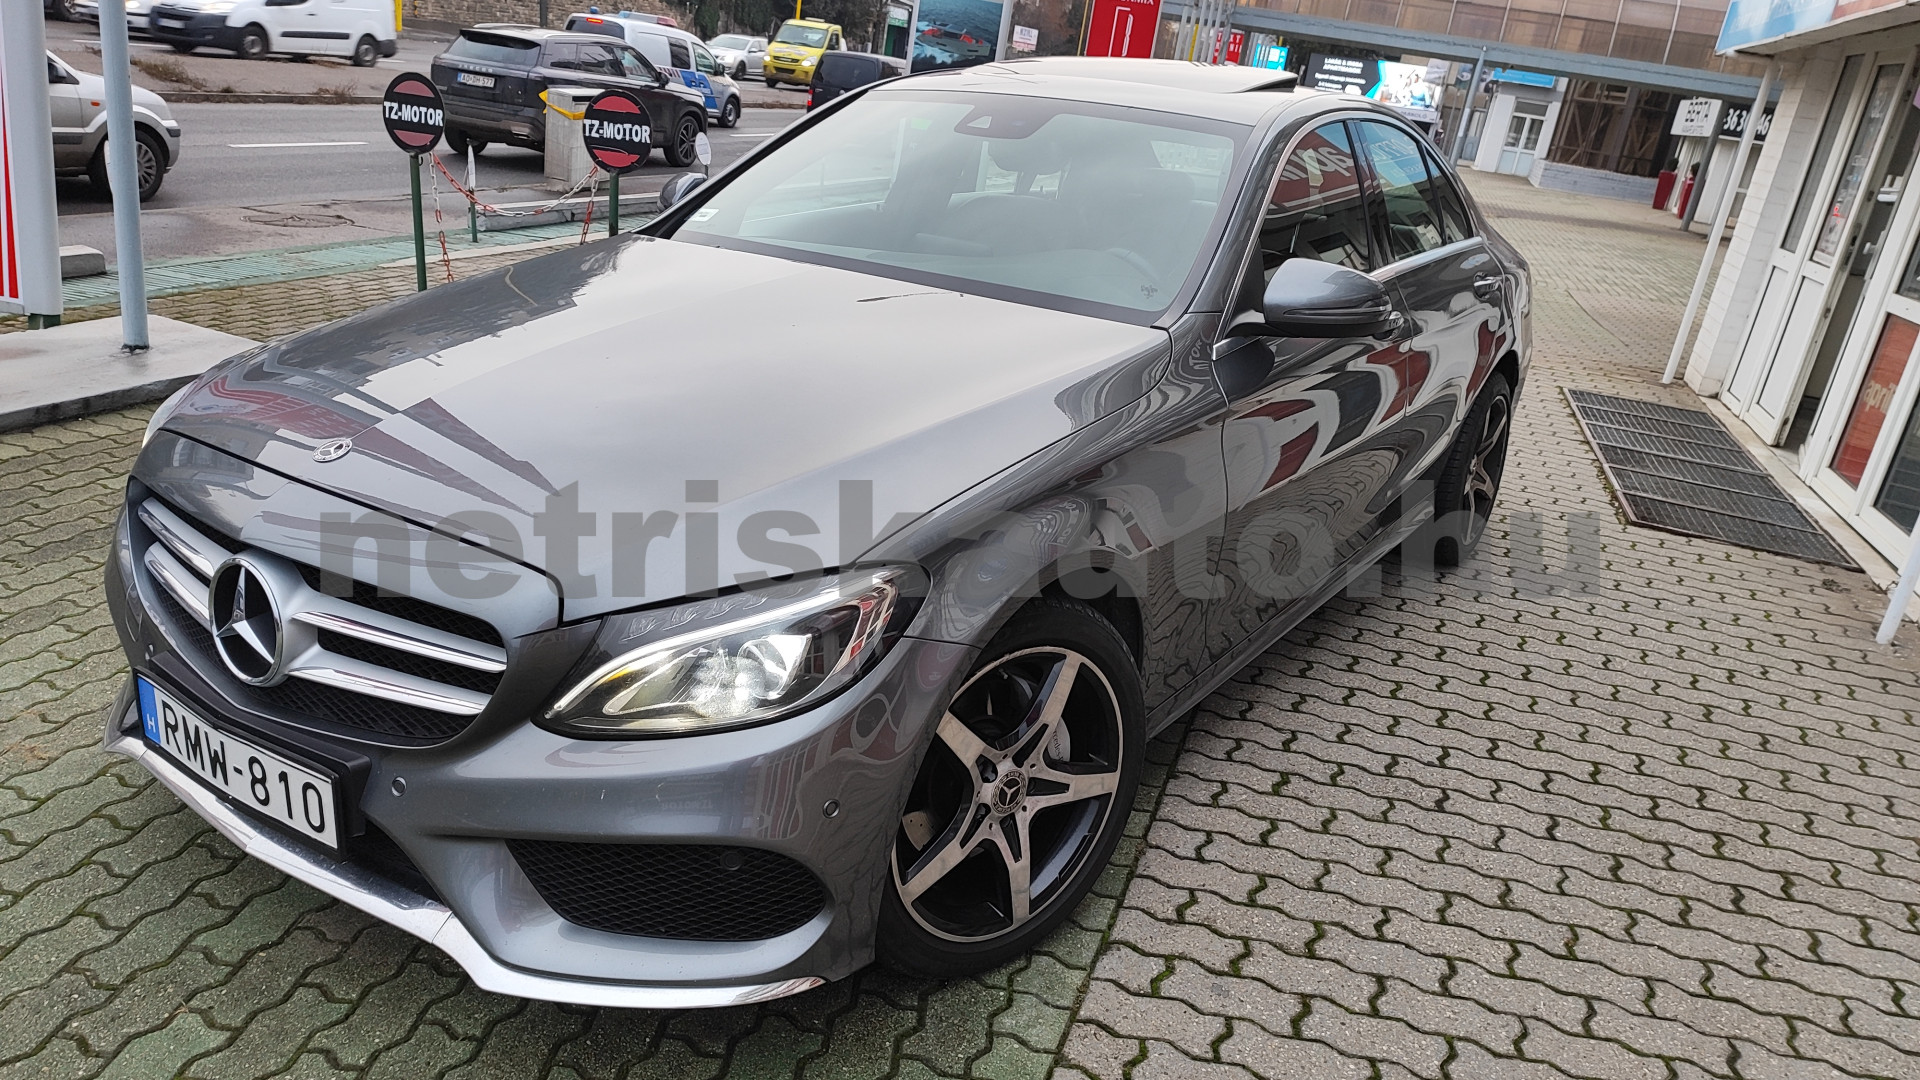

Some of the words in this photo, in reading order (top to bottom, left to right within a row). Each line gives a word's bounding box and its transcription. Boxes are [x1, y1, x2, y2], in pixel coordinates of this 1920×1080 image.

[383, 101, 444, 127] TZ-MOTOR
[584, 118, 651, 144] TZ-MOTOR
[146, 713, 156, 733] H
[161, 699, 325, 833] RMW-810
